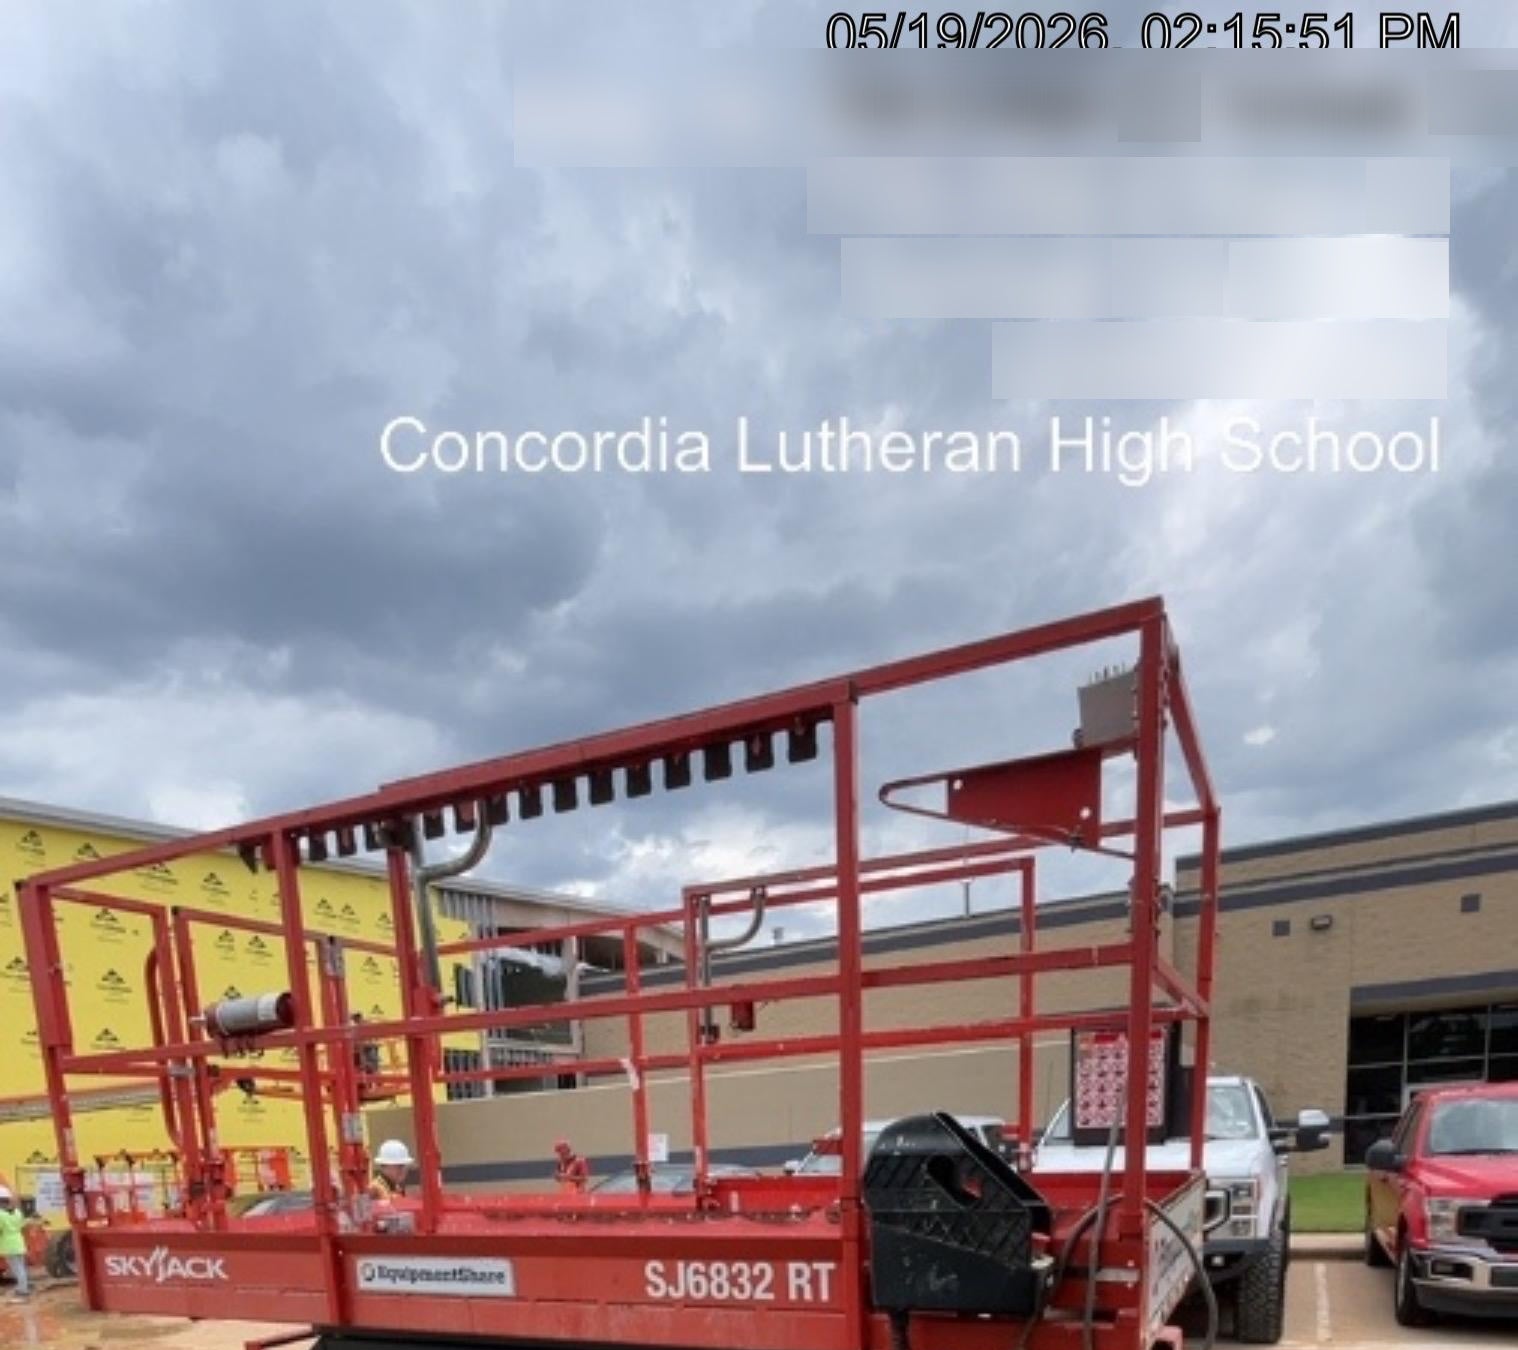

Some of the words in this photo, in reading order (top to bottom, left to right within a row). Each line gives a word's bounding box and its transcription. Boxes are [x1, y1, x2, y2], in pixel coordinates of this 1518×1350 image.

[104, 1246, 228, 1282] SKYJACK
[377, 1265, 506, 1285] EquipmentShare
[643, 1260, 775, 1300] SJ6832
[788, 1262, 836, 1302] RT
